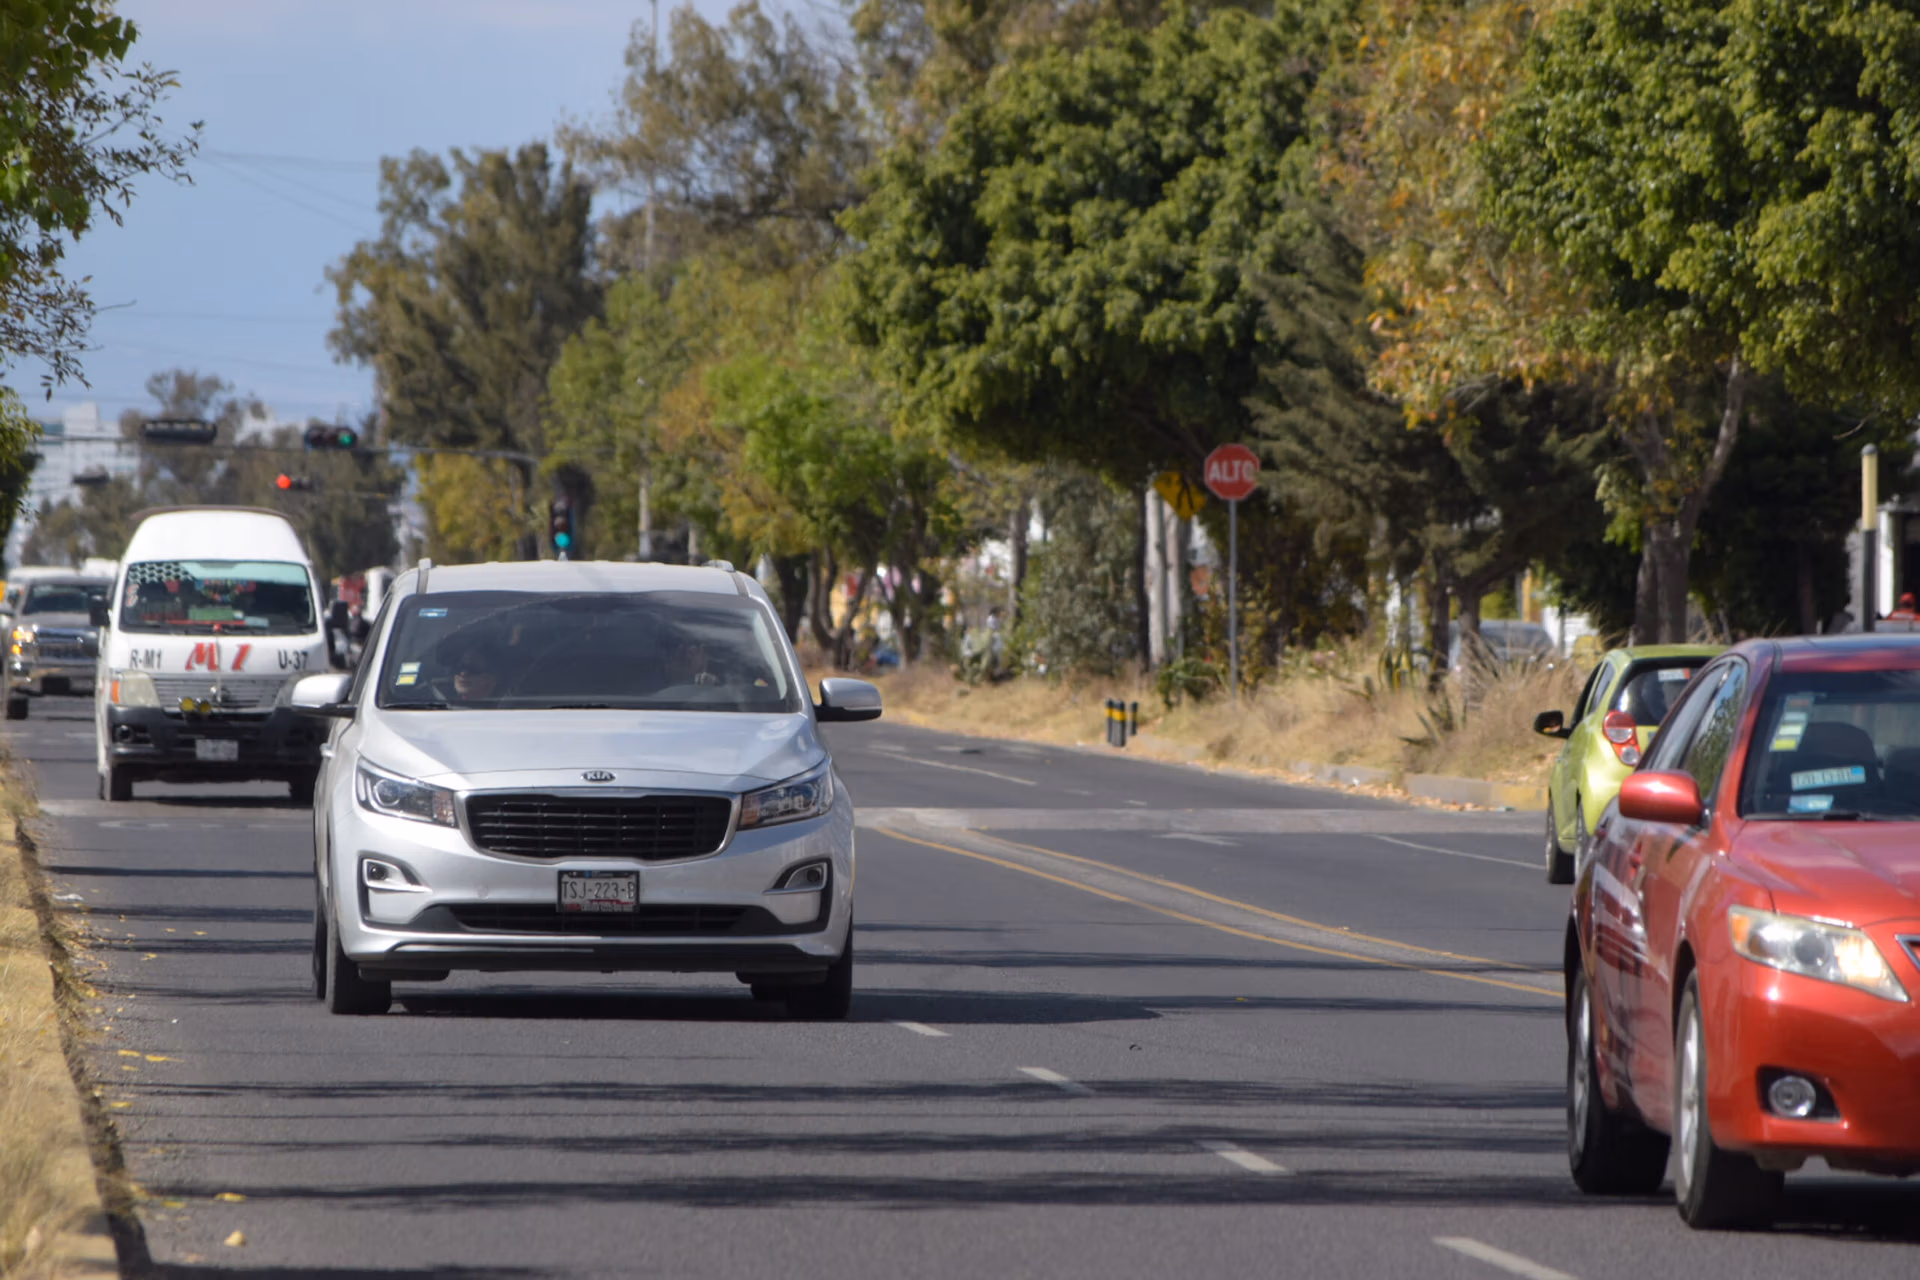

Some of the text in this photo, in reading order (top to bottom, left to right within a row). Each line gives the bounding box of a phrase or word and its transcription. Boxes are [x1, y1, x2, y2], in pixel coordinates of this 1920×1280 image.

[1209, 460, 1255, 482] ALTO
[130, 649, 162, 669] R-M1
[278, 649, 308, 670] U-37
[587, 771, 611, 779] KIA
[562, 881, 635, 899] TSJ-223-B
